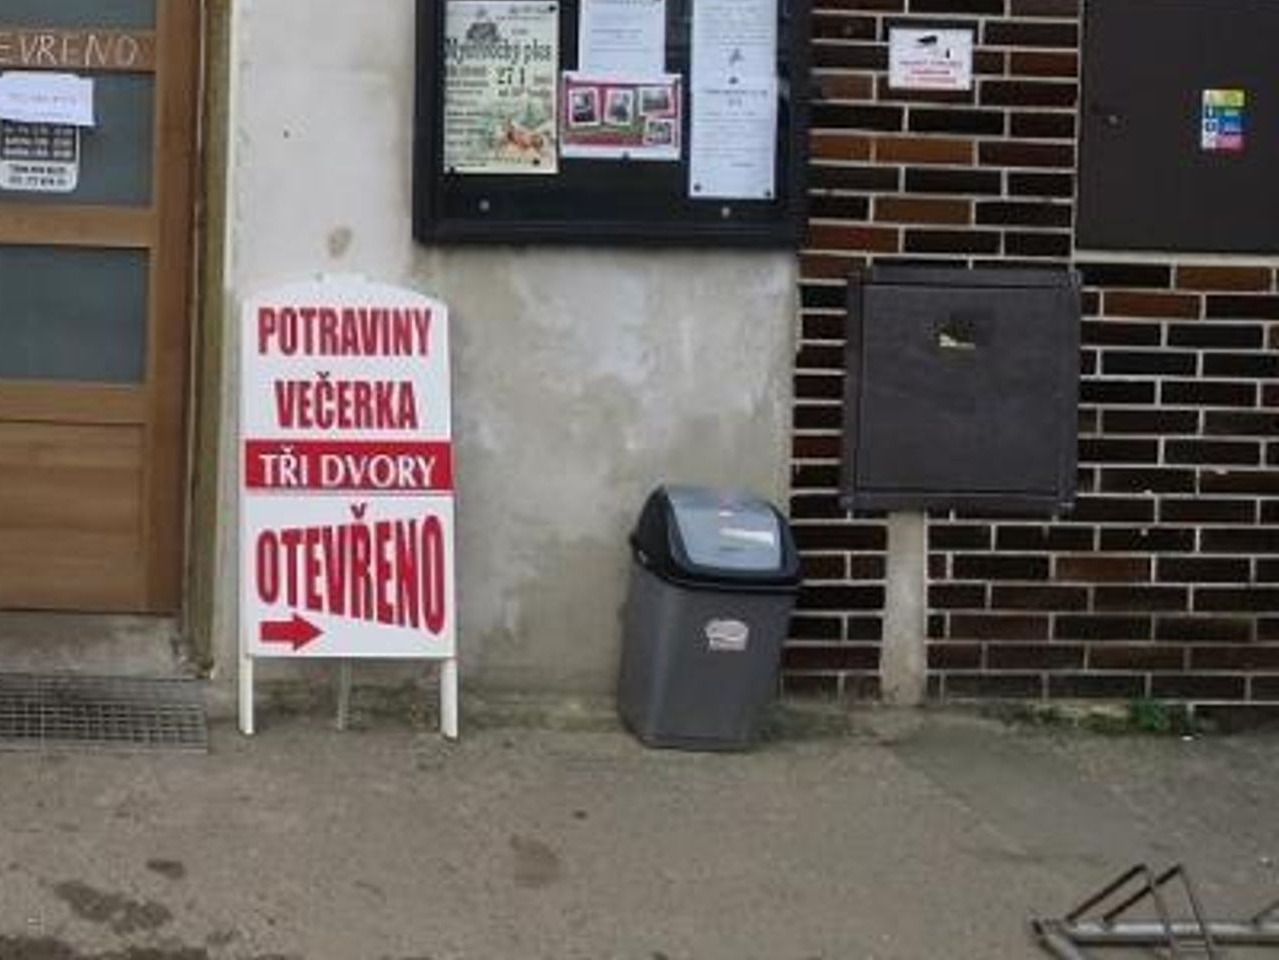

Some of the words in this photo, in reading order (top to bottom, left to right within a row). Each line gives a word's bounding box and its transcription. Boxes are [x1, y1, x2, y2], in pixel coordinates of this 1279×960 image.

[258, 307, 433, 357] POTRAVINY
[274, 371, 419, 430] VEČERKA
[259, 448, 308, 487] TŘI
[322, 453, 436, 487] DVORY
[255, 503, 446, 637] OTEVŘENO
